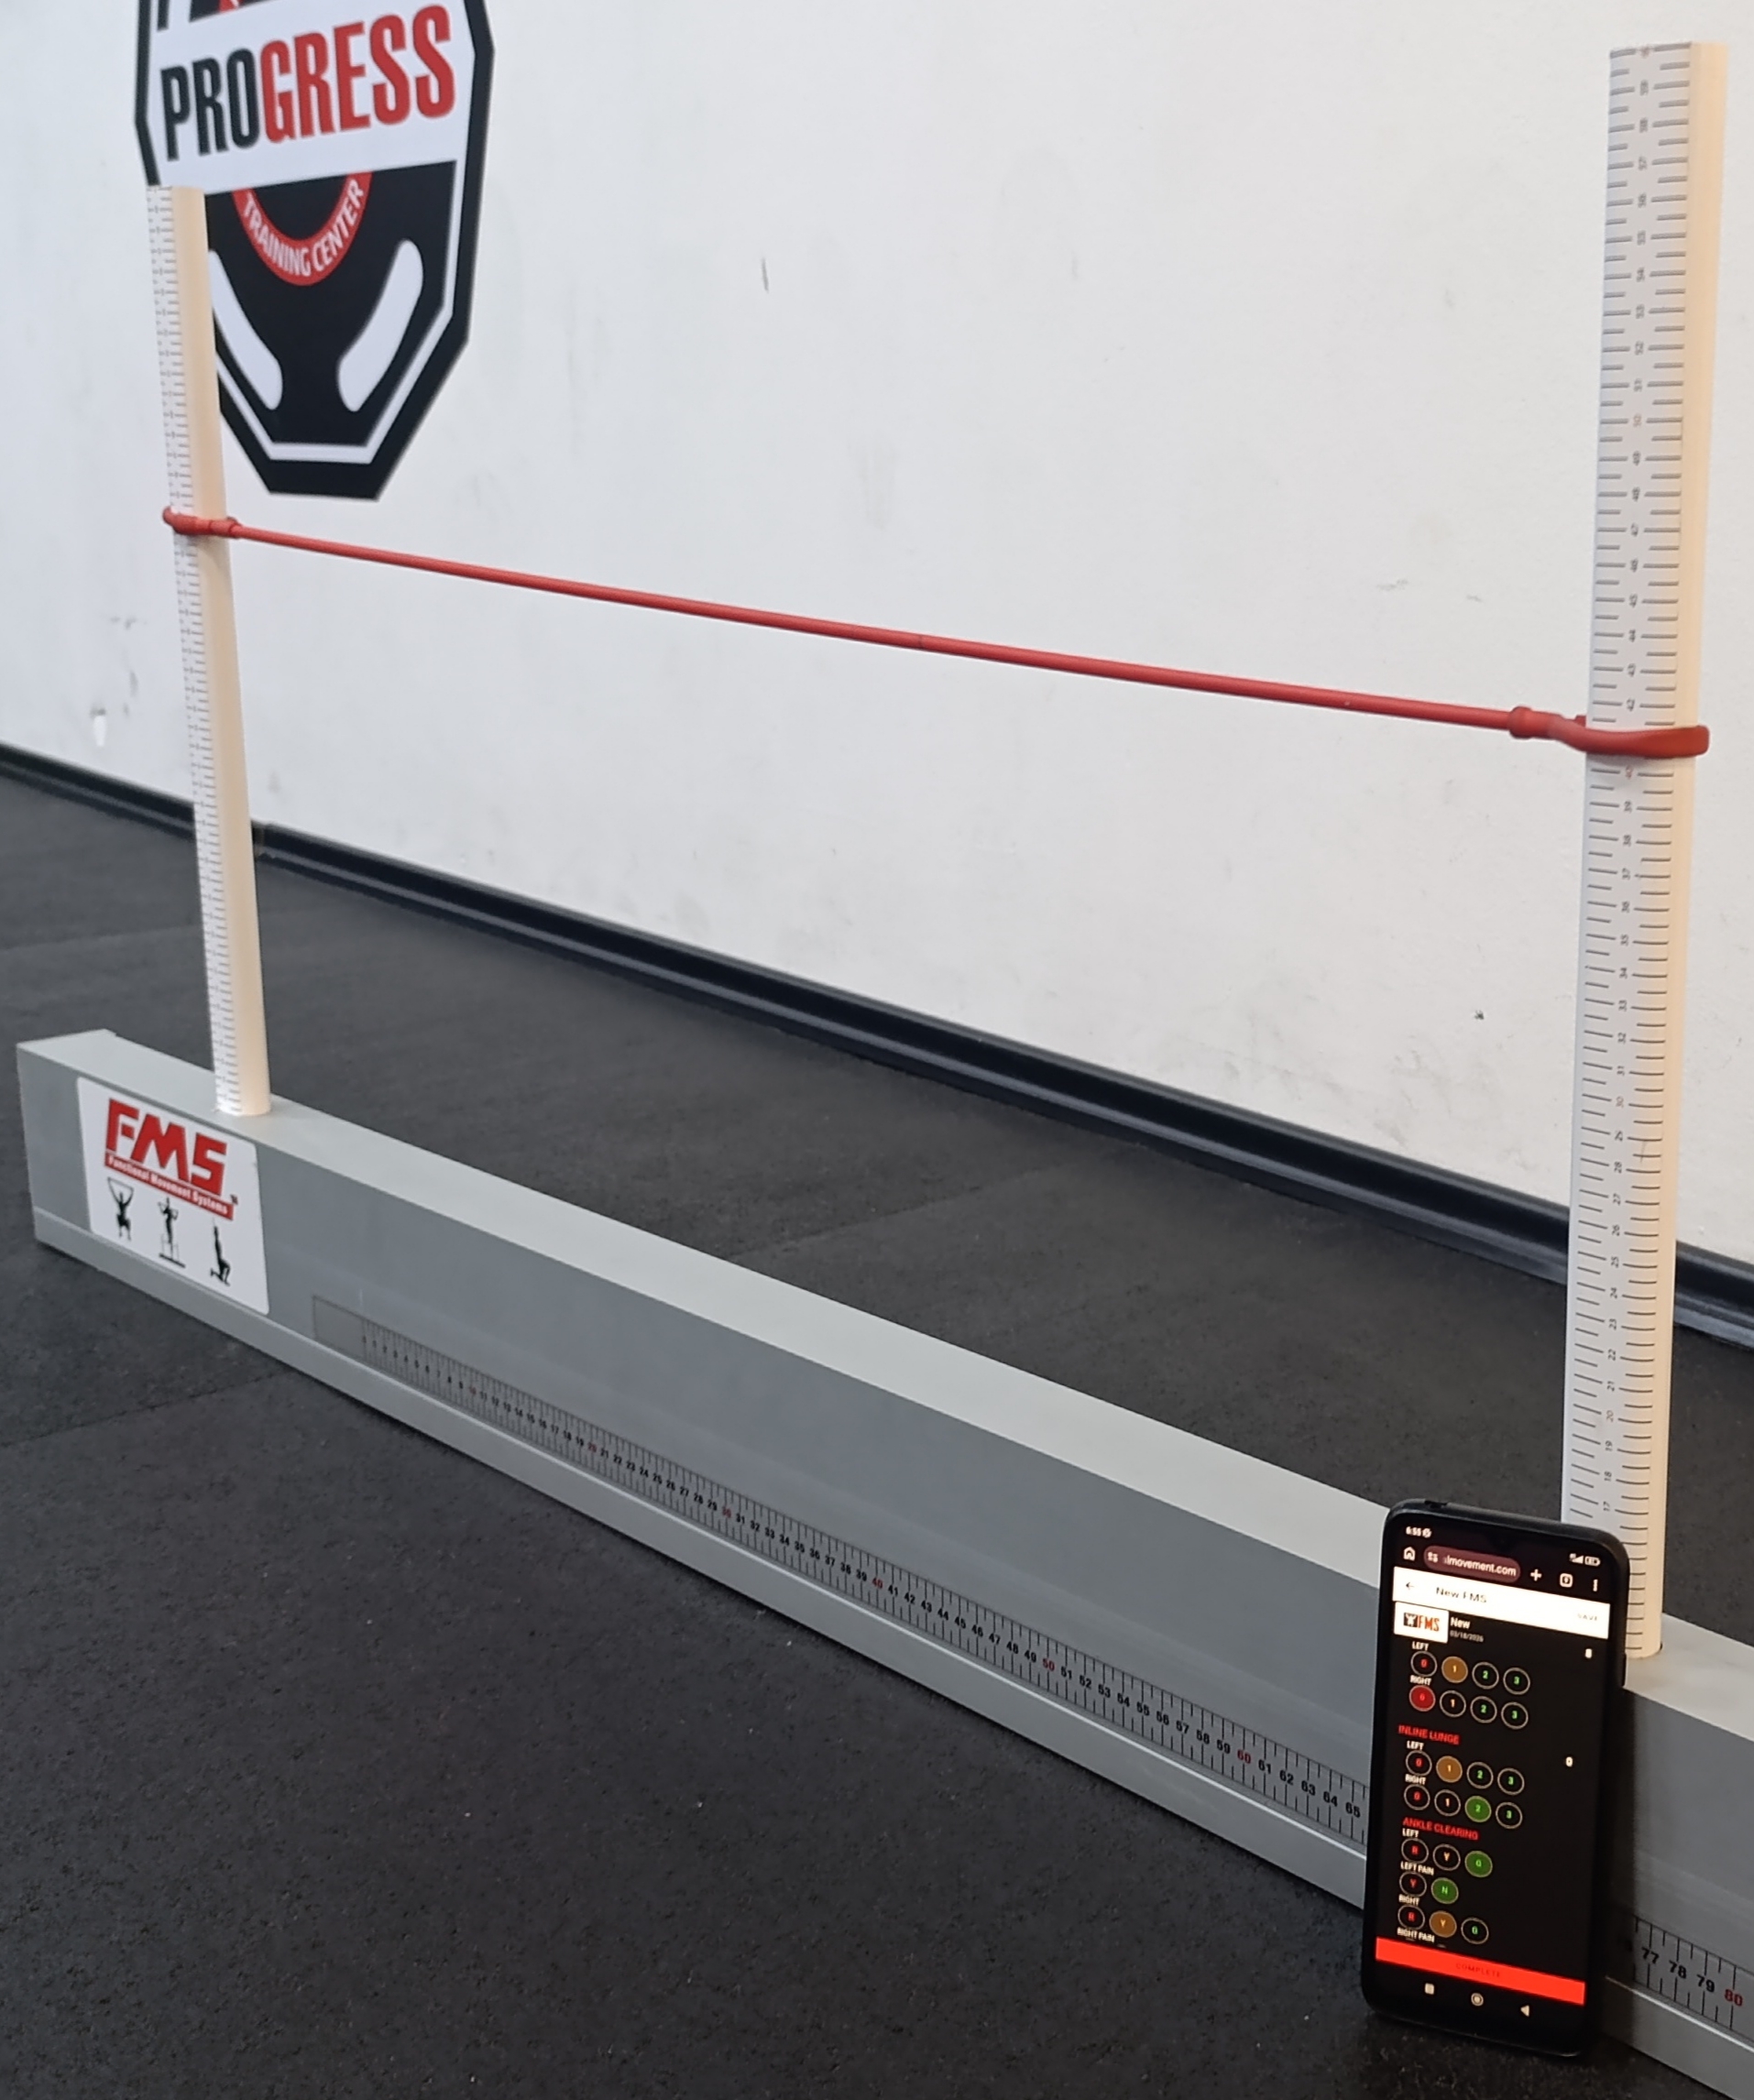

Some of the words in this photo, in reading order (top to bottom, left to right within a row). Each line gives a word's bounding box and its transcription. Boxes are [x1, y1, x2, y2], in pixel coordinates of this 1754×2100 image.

[159, 5, 455, 162] PROGRESS
[244, 191, 312, 277] TRAINING
[312, 179, 364, 272] CENTER
[1625, 801, 1632, 813] 39
[1624, 835, 1631, 847] 38
[1622, 868, 1630, 880] 37
[1622, 901, 1629, 913] 36
[1621, 935, 1628, 946] 35
[1620, 968, 1628, 979] 34
[1618, 1001, 1627, 1012] 33
[1618, 1032, 1626, 1044] 32
[1617, 1066, 1625, 1076] 31
[1616, 1096, 1624, 1108] 30
[1615, 1131, 1623, 1142] 29
[105, 1098, 227, 1196] FMS
[1614, 1162, 1622, 1174] 28
[150, 1173, 191, 1198] Movement
[192, 1191, 228, 1214] Systems
[1613, 1193, 1620, 1205] 27
[1612, 1225, 1620, 1236] 26
[1611, 1256, 1619, 1268] 25
[1610, 1287, 1617, 1299] 24
[1609, 1318, 1617, 1329] 23
[1608, 1349, 1616, 1361] 22
[1607, 1381, 1615, 1392] 21
[1606, 1410, 1614, 1422] 20
[1605, 1440, 1612, 1452] 19
[1605, 1471, 1612, 1482] 18
[1603, 1501, 1610, 1512] 17
[1436, 1587, 1459, 1598] New
[551, 1425, 559, 1435] 17
[564, 1430, 571, 1440] 18
[576, 1436, 584, 1446] 19
[601, 1449, 608, 1459] 21
[614, 1454, 622, 1465] 22
[627, 1460, 635, 1471] 23
[640, 1467, 649, 1478] 24
[653, 1473, 662, 1484] 25
[666, 1480, 675, 1491] 26
[680, 1486, 688, 1497] 27
[694, 1493, 703, 1504] 28
[707, 1499, 717, 1511] 29
[736, 1514, 744, 1525] 31
[751, 1520, 760, 1532] 32
[765, 1527, 774, 1539] 33
[780, 1534, 789, 1546] 34
[795, 1541, 805, 1553] 35
[810, 1548, 819, 1560] 36
[826, 1556, 835, 1567] 37
[840, 1562, 850, 1574] 38
[857, 1570, 867, 1581] 39
[872, 1577, 882, 1589] 40
[888, 1585, 898, 1597] 41
[904, 1592, 915, 1604] 42
[921, 1600, 931, 1613] 43
[937, 1607, 948, 1621] 44
[955, 1615, 966, 1629] 45
[971, 1624, 983, 1637] 46
[989, 1633, 1001, 1645] 47
[1006, 1641, 1018, 1654] 48
[1025, 1649, 1036, 1663] 49
[1043, 1657, 1054, 1671] 50
[1061, 1666, 1072, 1680] 51
[1080, 1675, 1091, 1688] 52
[1099, 1684, 1110, 1698] 53
[1117, 1693, 1130, 1707] 54
[1137, 1702, 1149, 1716] 55
[1157, 1712, 1169, 1725] 56
[1176, 1721, 1189, 1734] 57
[1196, 1730, 1210, 1744] 58
[1217, 1740, 1230, 1754] 59
[1237, 1750, 1251, 1764] 60
[1258, 1759, 1271, 1774] 61
[1279, 1769, 1293, 1785] 62
[1301, 1780, 1315, 1796] 63
[1323, 1791, 1337, 1807] 64
[1345, 1802, 1360, 1818] 65
[1417, 1614, 1440, 1632] FMS
[1451, 1617, 1470, 1629] New
[1412, 1641, 1429, 1651] LEFT
[1421, 1659, 1428, 1668] 0
[1483, 1670, 1488, 1679] 2
[1514, 1677, 1519, 1685] 3
[1410, 1675, 1431, 1685] RIGHT
[1481, 1704, 1486, 1713] 2
[1512, 1711, 1518, 1719] 3
[1398, 1725, 1428, 1738] INLINE
[1430, 1731, 1459, 1745] LUNGE
[1407, 1741, 1424, 1751] LEFT
[1416, 1758, 1421, 1766] 0
[1477, 1770, 1483, 1778] 2
[1508, 1777, 1514, 1785] 3
[1405, 1774, 1426, 1785] RIGHT
[1414, 1792, 1420, 1800] 0
[1507, 1810, 1512, 1819] 3
[1402, 1828, 1419, 1837] LEFT
[1403, 1817, 1431, 1831] ANKLE
[1434, 1823, 1478, 1840] CLEARING
[1444, 1853, 1450, 1861] Y
[1400, 1861, 1418, 1871] LEFT
[1418, 1865, 1433, 1876] PAIN
[1398, 1894, 1420, 1905] RIGHT
[1398, 1927, 1418, 1939] RIGHT
[1419, 1931, 1434, 1942] PAIN
[1642, 1947, 1659, 1964] 77
[1669, 1960, 1686, 1979] 78
[1697, 1974, 1715, 1993] 79
[1725, 1989, 1743, 2006] 80
